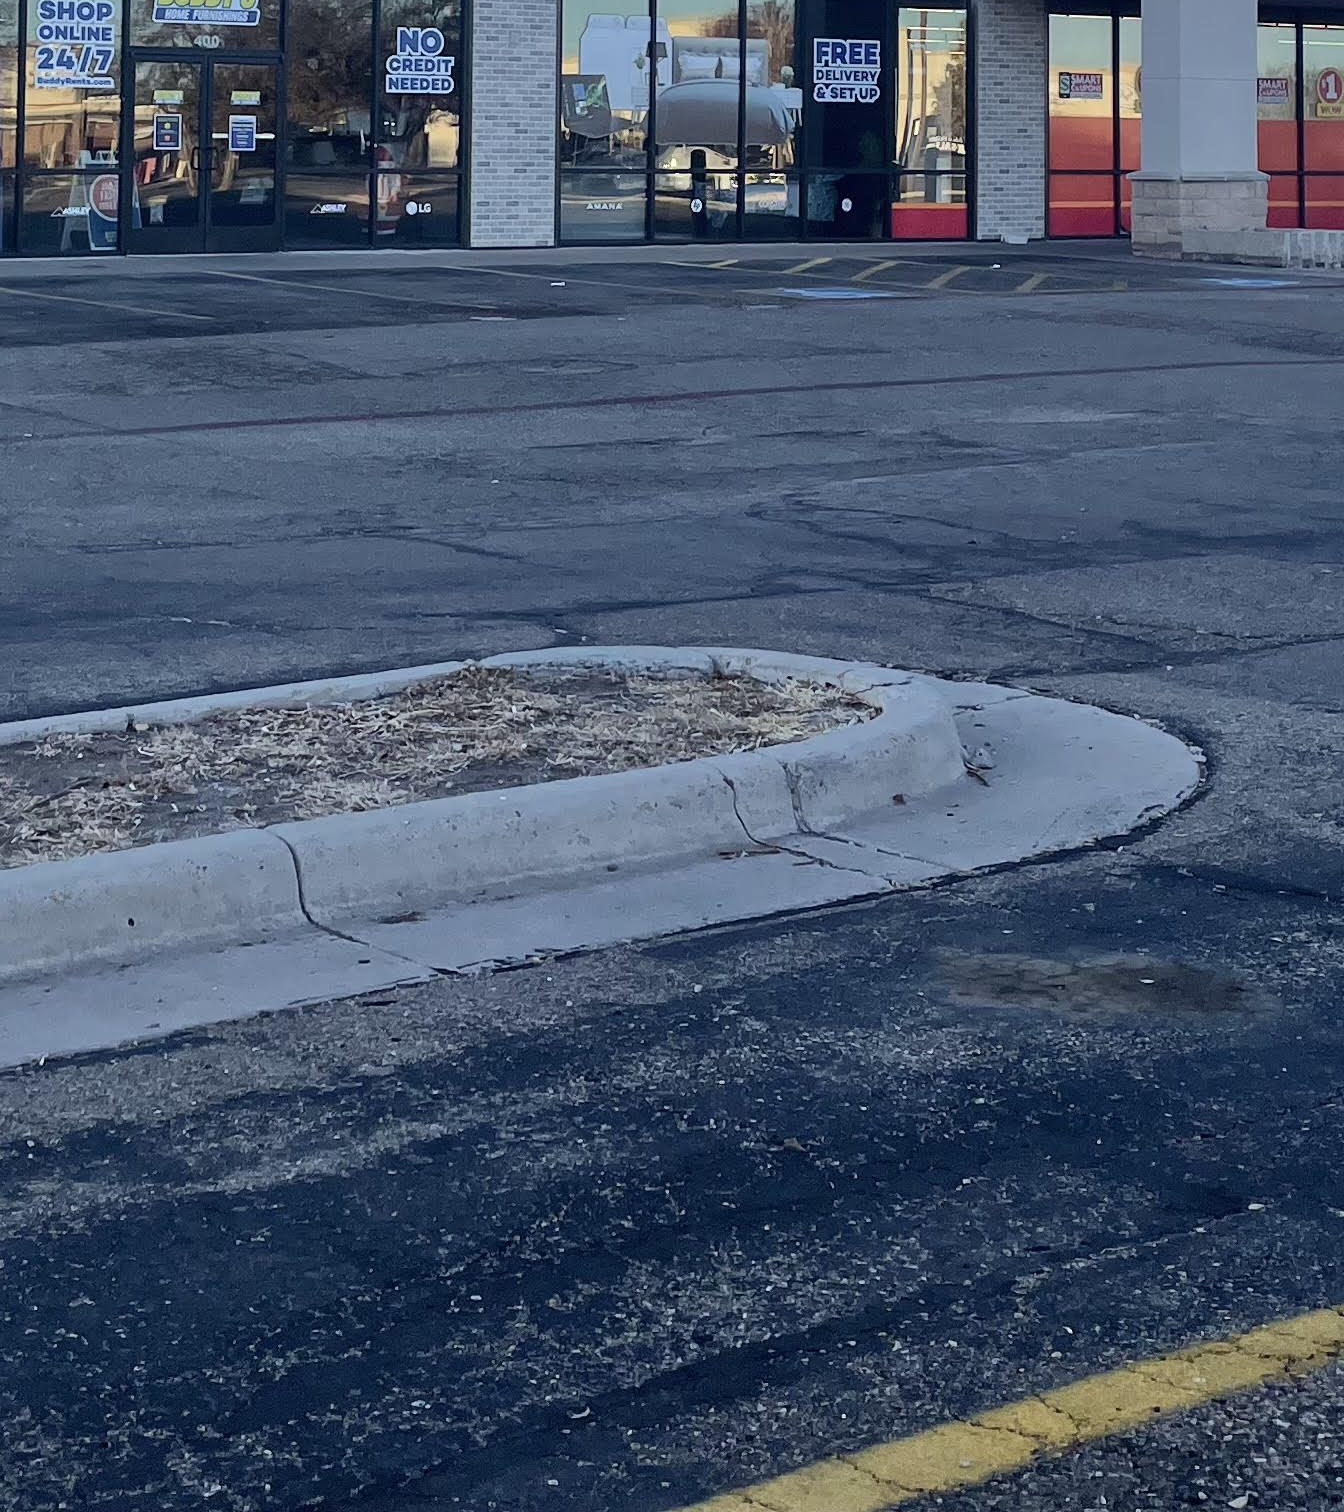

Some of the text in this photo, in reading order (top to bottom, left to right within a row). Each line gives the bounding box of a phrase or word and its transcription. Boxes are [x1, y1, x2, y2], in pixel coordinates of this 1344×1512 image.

[39, 0, 113, 21] SHOP
[164, 8, 249, 22] HOME FURNISHINGS
[39, 25, 113, 41] ONLINE
[399, 29, 442, 54] NO
[37, 47, 112, 72] 24/7
[816, 41, 878, 65] FREE
[389, 58, 452, 72] CREDIT
[37, 76, 112, 86] BuddyRents.com
[816, 70, 877, 82] DELIVERY
[1071, 75, 1101, 85] SMART
[388, 77, 452, 91] NEEDED
[1259, 79, 1287, 88] SMART
[817, 87, 877, 100] & SET UP
[585, 202, 623, 210] AMANA
